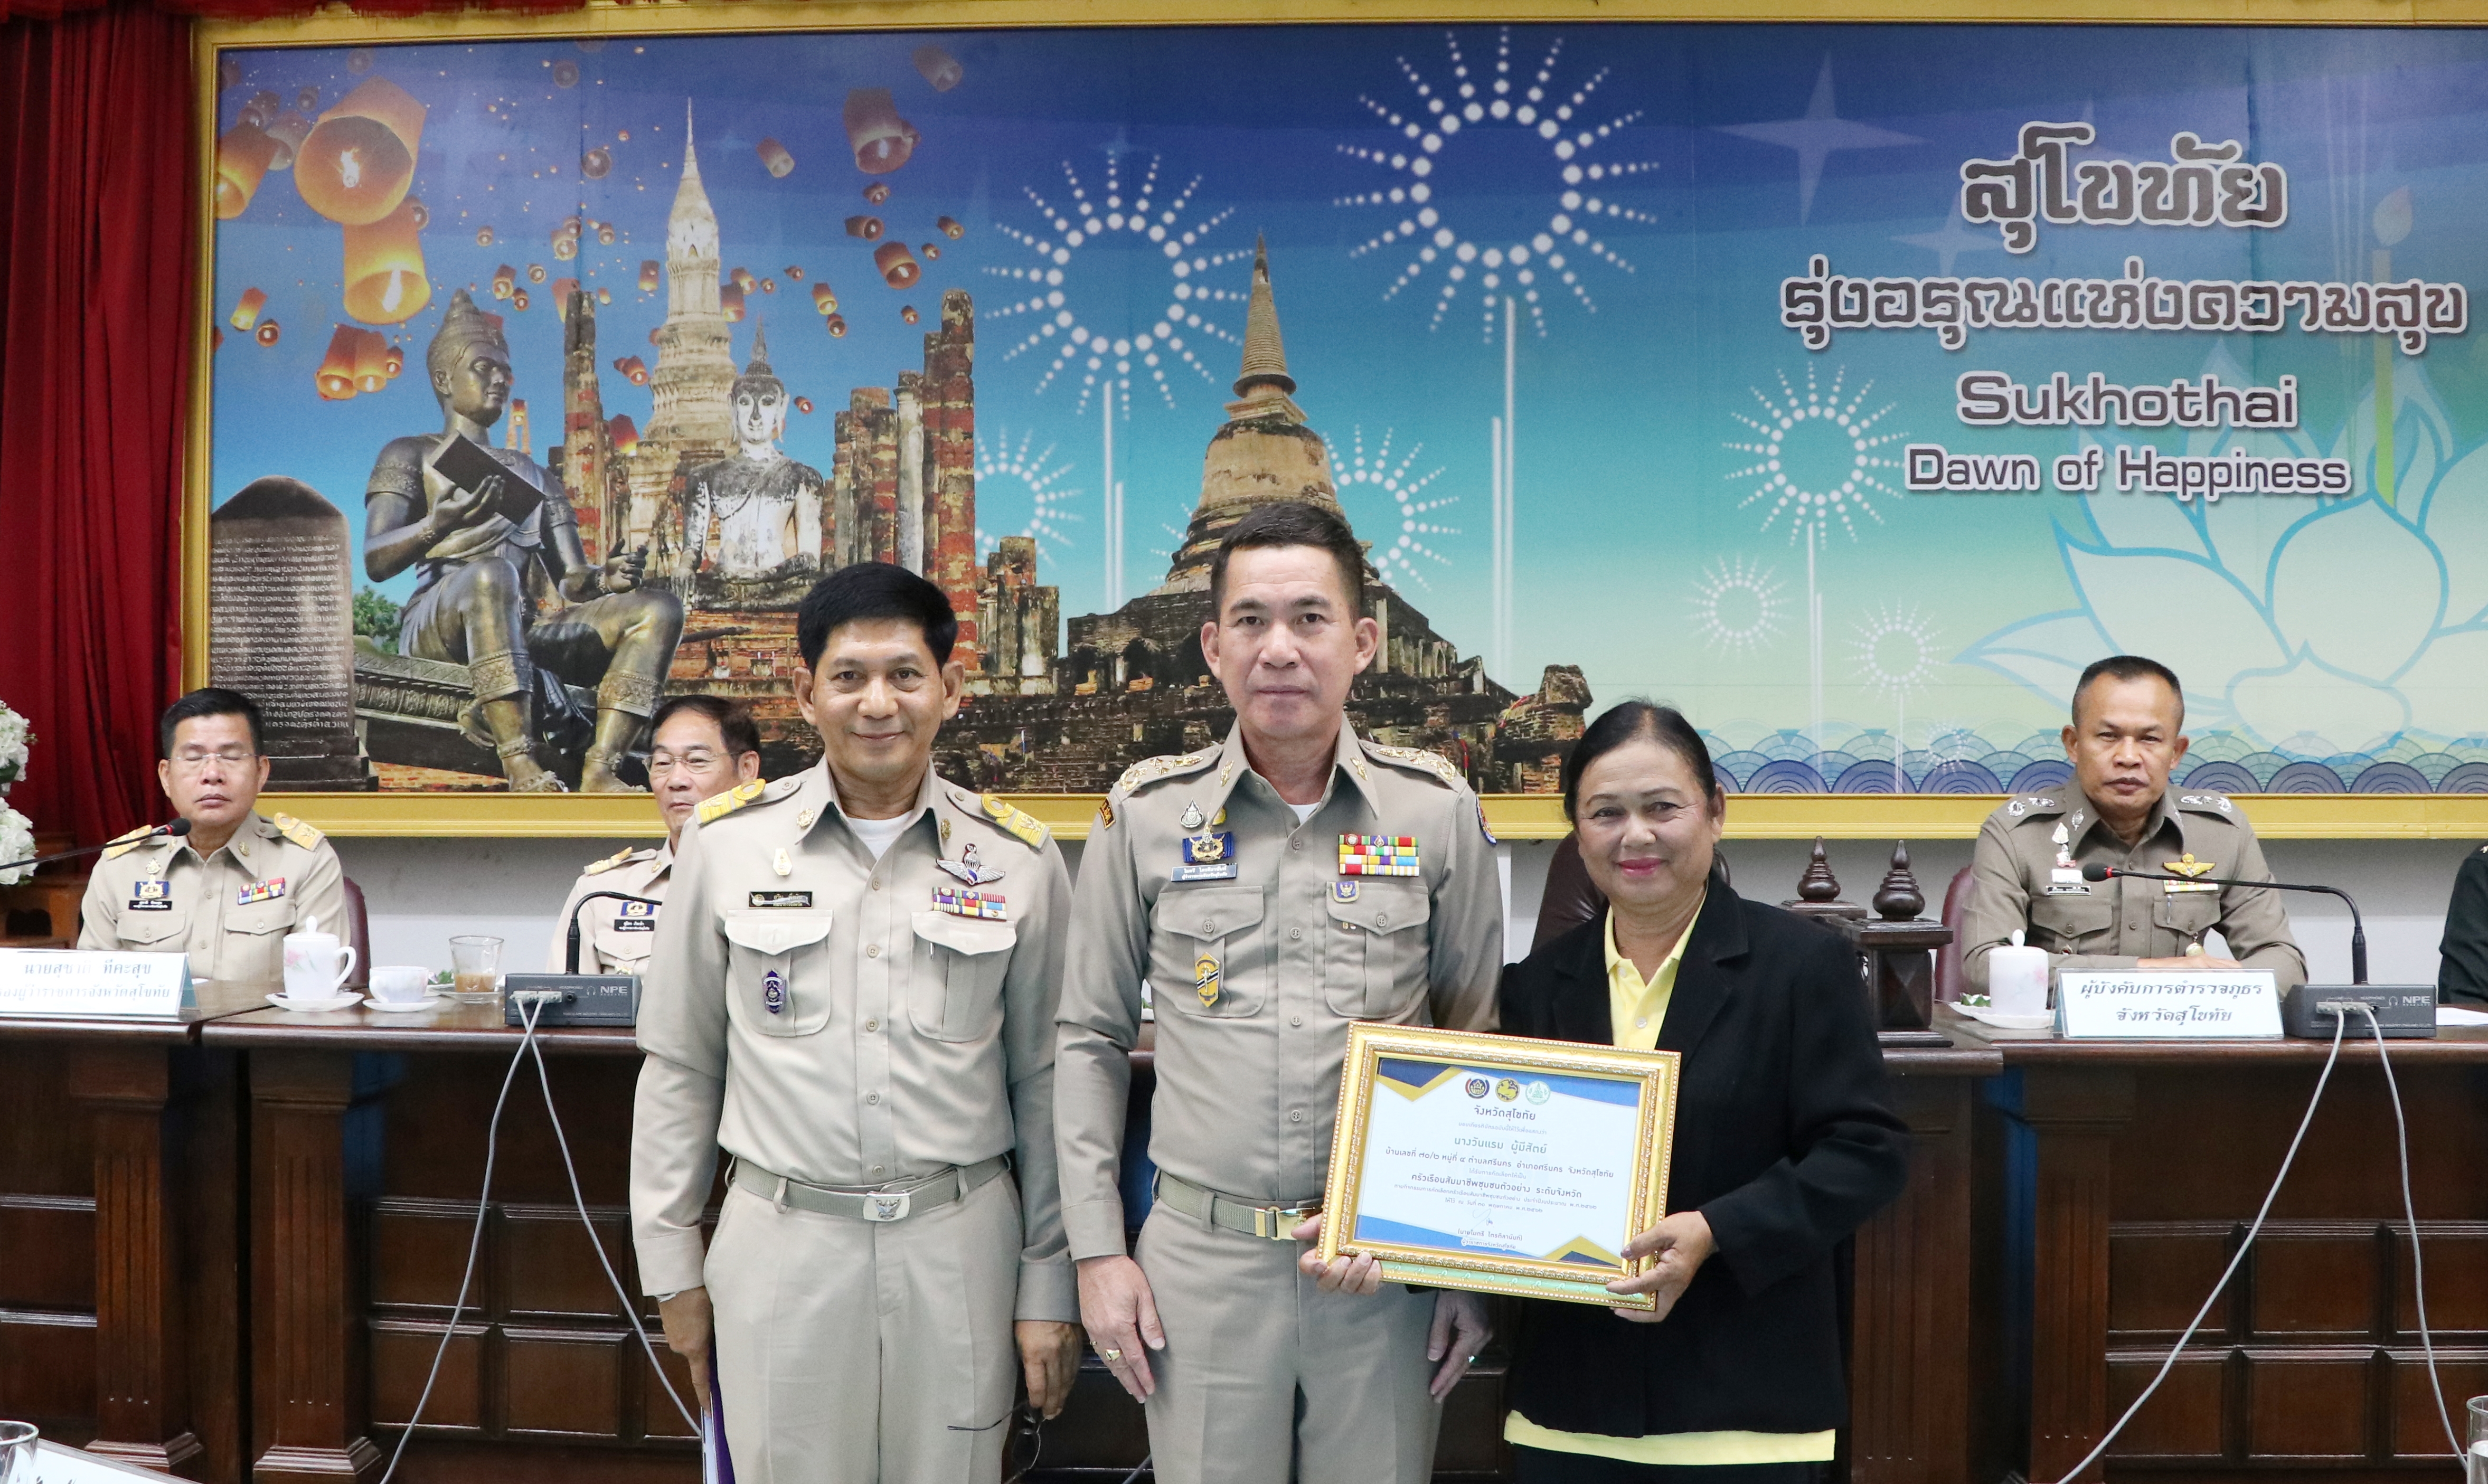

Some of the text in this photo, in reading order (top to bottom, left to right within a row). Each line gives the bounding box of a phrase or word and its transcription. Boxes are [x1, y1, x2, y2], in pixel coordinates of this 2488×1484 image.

[1961, 121, 2289, 252] สุโขทัย
[1780, 254, 2469, 354] รุ่งอรุณแห่งความสุข
[1956, 370, 2297, 428] Sukhothai
[1905, 443, 2352, 503] Dawn of Happiness
[2080, 978, 2263, 1000] ผู้บังคับการตำรวจภูธร
[2116, 1007, 2232, 1026] จังหวัดสุโขทัย
[1474, 1105, 1536, 1121] จังหวัดสุโขทัย
[1454, 1137, 1504, 1150] นางวันแรม
[1386, 1146, 1417, 1158] บ้านเลขที่
[1442, 1152, 1458, 1163] หมู่ที่
[1468, 1156, 1512, 1167] ตำบลศรีนคร
[1516, 1161, 1563, 1173] อำเภอศรีนคร
[1568, 1166, 1614, 1178] จังหวัดสุโขทัย
[1411, 1173, 1582, 1198] ครัวเรือนสัมมาชีพชุมชนตัวอย่าง ระดับจังหวัด
